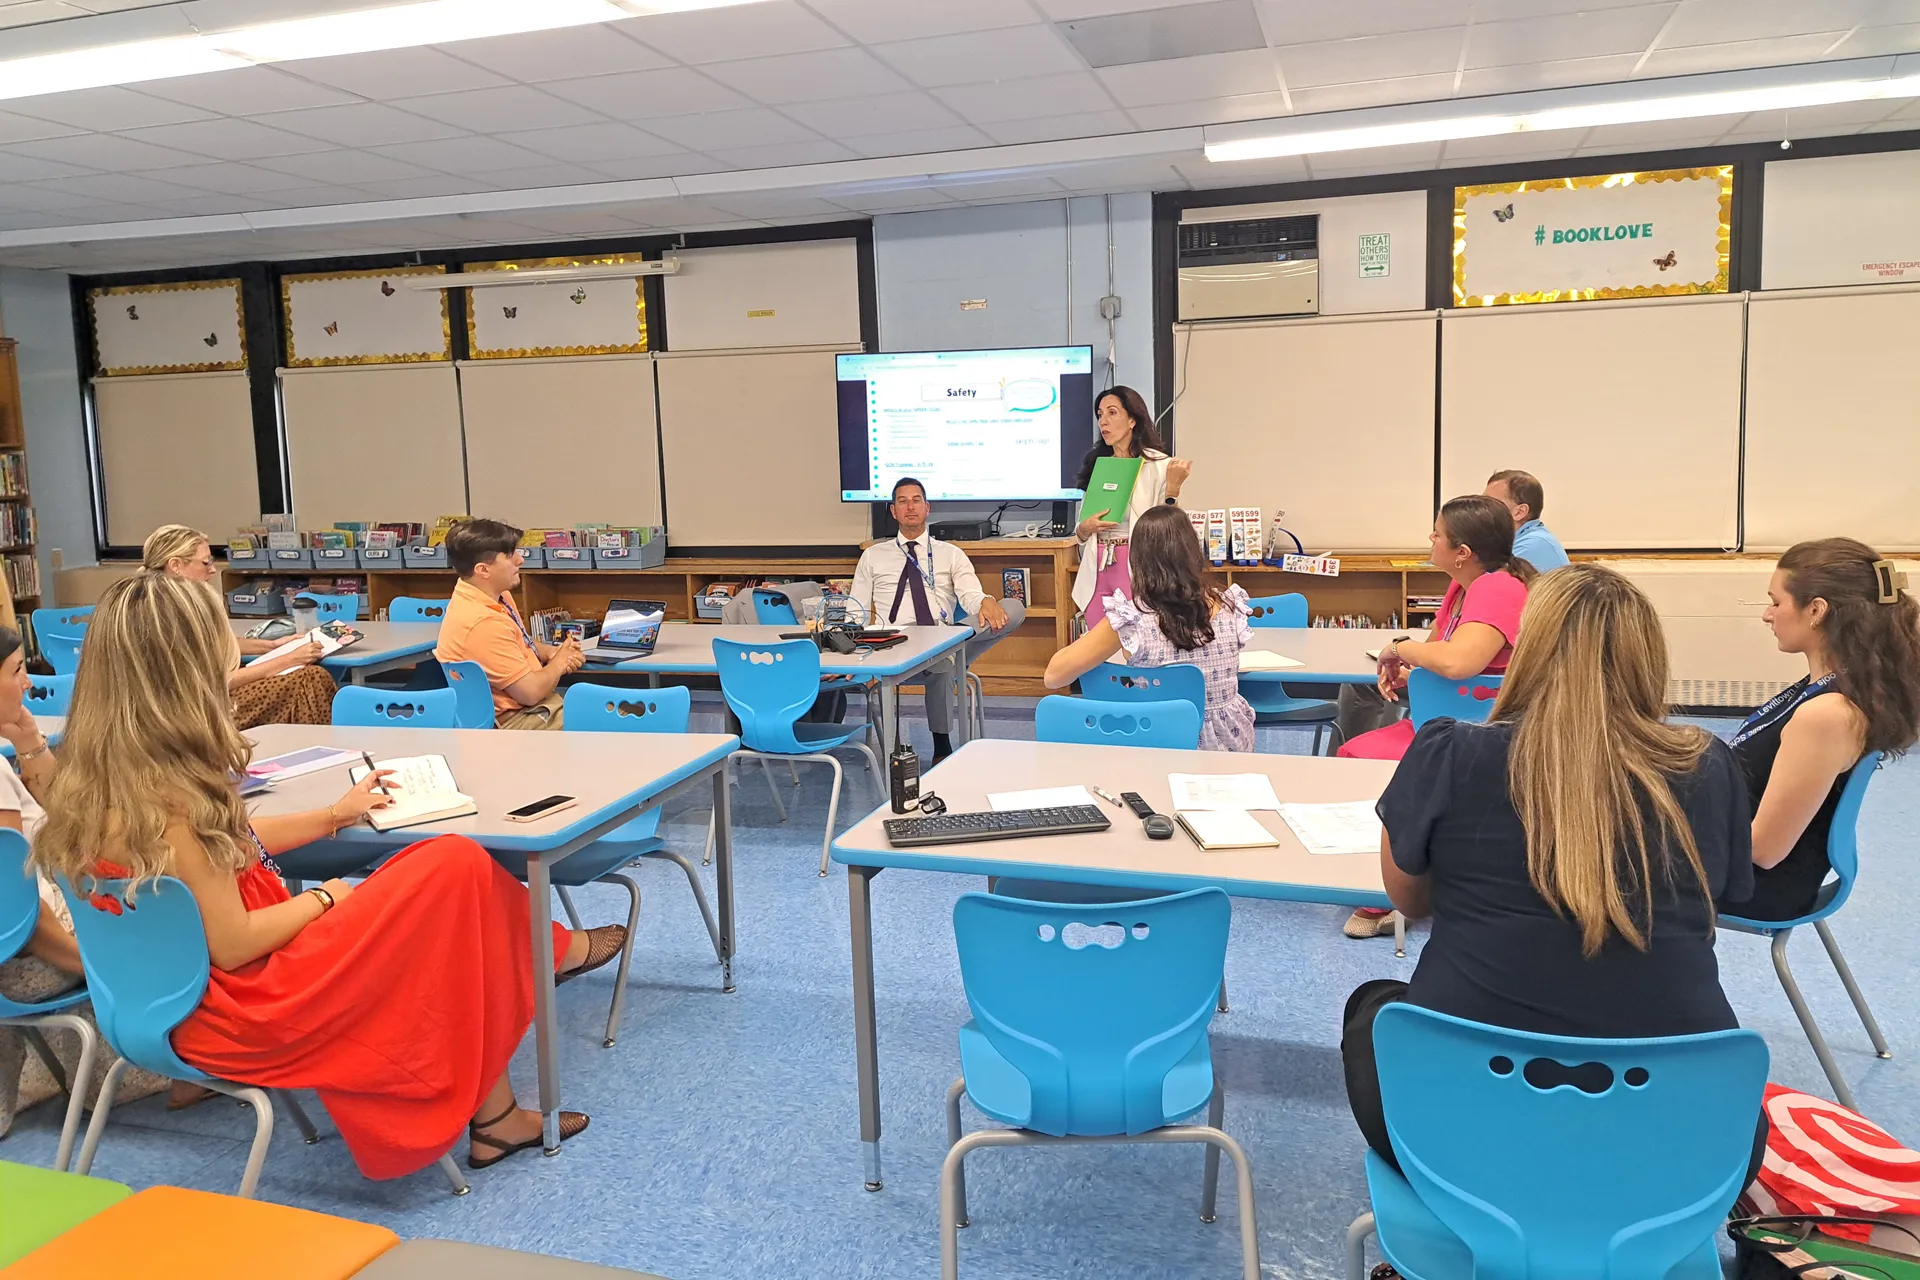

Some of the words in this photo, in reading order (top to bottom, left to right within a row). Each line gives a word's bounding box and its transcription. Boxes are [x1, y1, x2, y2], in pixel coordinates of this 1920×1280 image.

[1535, 225, 1545, 246] #
[1552, 223, 1653, 244] BOOKLOVE
[1361, 235, 1388, 246] TREAT
[1360, 246, 1388, 255] OTHERS
[1899, 261, 1920, 269] ESCAPE
[947, 388, 976, 398] Safety
[1328, 560, 1336, 574] 394
[1757, 687, 1796, 717] Levittown
